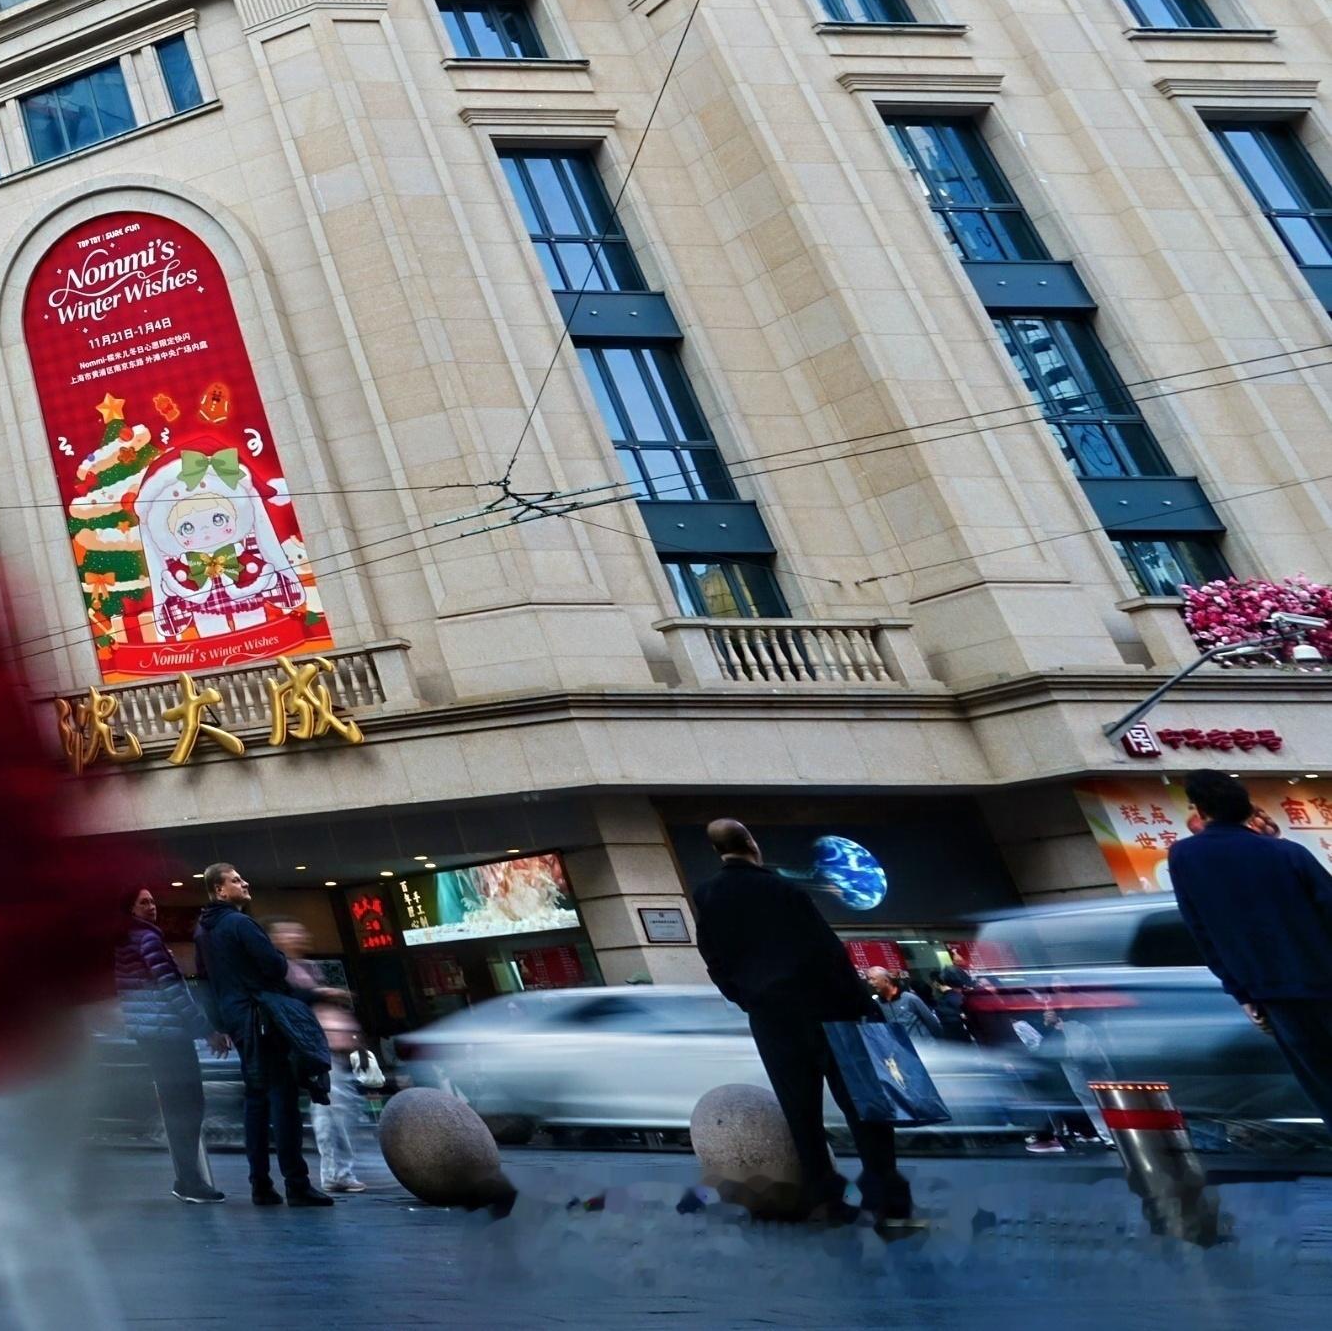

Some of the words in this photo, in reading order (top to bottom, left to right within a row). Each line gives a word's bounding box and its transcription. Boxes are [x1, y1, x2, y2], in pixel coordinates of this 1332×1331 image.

[77, 239, 90, 249] TOP
[89, 235, 102, 245] TOY
[50, 238, 177, 305] Nommi's
[57, 291, 122, 324] Winter
[124, 268, 198, 304] Wishes
[88, 317, 172, 349] 11月21日-1月4日
[140, 648, 207, 669] Nommi's
[209, 643, 242, 662] Winter
[244, 633, 280, 653] Wishes
